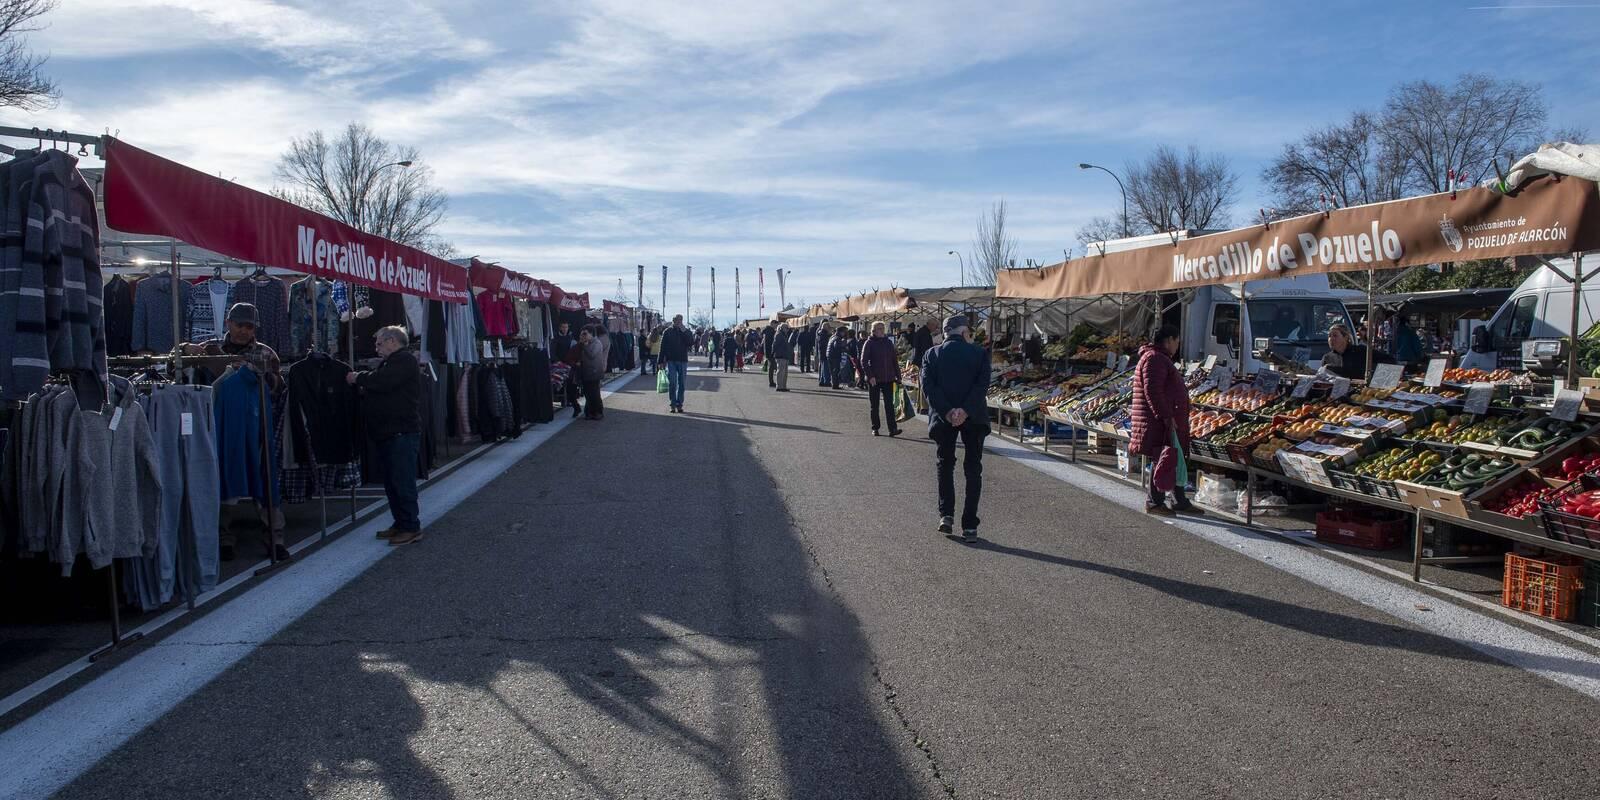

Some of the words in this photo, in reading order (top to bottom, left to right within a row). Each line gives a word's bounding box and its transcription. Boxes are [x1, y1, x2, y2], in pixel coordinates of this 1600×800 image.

[1463, 218, 1516, 233] Ayuntamiento
[1517, 216, 1526, 226] de
[1467, 234, 1507, 249] POZUELO
[1507, 232, 1518, 245] DE
[1519, 221, 1567, 242] ALARCÓN
[297, 225, 377, 282] Mercadillo
[379, 251, 395, 286] de
[1172, 241, 1262, 283] Mercadillo
[1266, 236, 1298, 272] de
[1298, 220, 1403, 267] Pozuelo
